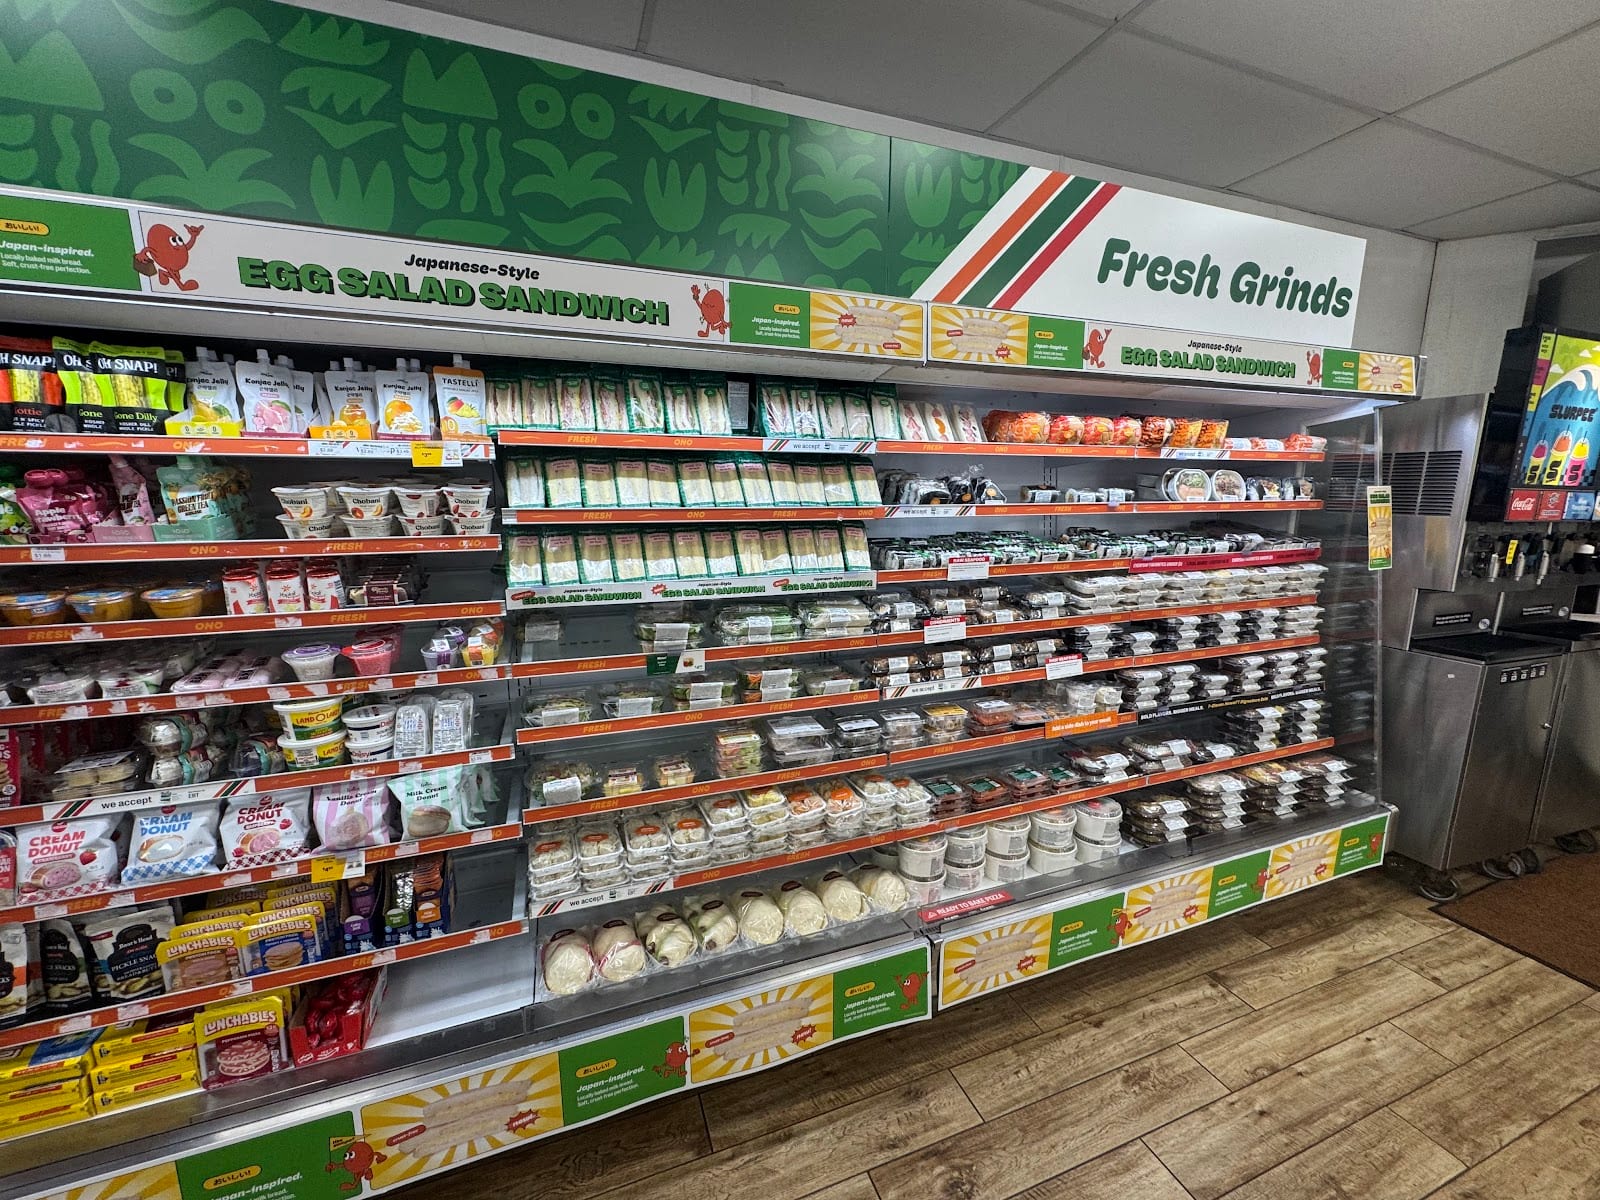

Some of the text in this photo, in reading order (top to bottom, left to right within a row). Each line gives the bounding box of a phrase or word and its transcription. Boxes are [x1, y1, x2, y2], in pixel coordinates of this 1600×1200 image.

[0, 240, 94, 257] Japan-inspired.
[404, 254, 540, 281] Japanese-Style
[1097, 237, 1353, 318] Fresh Grinds
[237, 256, 670, 326] EGG SALAD SANDWICH
[751, 316, 801, 327] Japan-inspired.
[1187, 339, 1243, 354] Japanese-Style
[63, 354, 82, 367] OH
[1120, 346, 1297, 378] EGG SALAD SANDWICH
[114, 358, 158, 374] SNAP!
[211, 378, 229, 386] Jelly
[245, 378, 271, 387] Konjac
[1549, 404, 1597, 422] SLURPEE
[567, 435, 598, 443] FRESH
[803, 442, 820, 450] accept
[352, 497, 381, 505] Chobani
[454, 497, 480, 505] Chobani
[35, 507, 66, 517] Apple
[583, 511, 612, 520] FRESH
[189, 545, 219, 554] ONO
[327, 542, 363, 551] FRESH
[661, 585, 766, 598] EGG SALAD SANDWICH
[781, 584, 800, 592] EGG
[800, 582, 828, 591] SALAD
[522, 596, 547, 605] EGG
[546, 594, 584, 604] SALAD
[585, 592, 642, 602] SANDWICH
[461, 606, 483, 615] ONO
[330, 613, 367, 622] FRESH
[195, 621, 224, 631] ONO
[27, 629, 73, 641] FRESH
[765, 645, 789, 653] FRESH
[577, 661, 606, 669] FRESH
[769, 702, 793, 711] FRESH
[296, 717, 315, 725] LAND
[685, 712, 703, 721] ONO
[583, 723, 612, 733] FRESH
[861, 759, 876, 767] ONO
[777, 771, 801, 780] FRESH
[355, 788, 377, 798] Cream
[406, 784, 448, 798] Milk Cream
[692, 784, 710, 793] ONO
[416, 792, 439, 801] Donut
[100, 796, 153, 809] we accept
[340, 798, 362, 806] Donut
[590, 800, 619, 810] FRESH
[238, 802, 286, 815] CREAM
[140, 812, 193, 826] CREAM
[237, 809, 283, 824] DONUT
[140, 822, 191, 837] DONUT
[29, 830, 86, 846] CREAM
[870, 836, 886, 844] ONO
[28, 842, 83, 858] DONUT
[702, 870, 720, 879] ONO
[569, 895, 604, 907] we accept
[936, 904, 958, 914] READY
[967, 898, 985, 908] BAKE
[985, 893, 1004, 904] PIZZA
[248, 919, 312, 940] LUNCHABLES
[166, 935, 234, 958] LUNCHABLES
[111, 958, 139, 972] PICKLE
[843, 990, 897, 1011] Japan-inspired.
[204, 1009, 276, 1036] LUNCHABLES
[576, 1065, 646, 1093] Japan-inspired.
